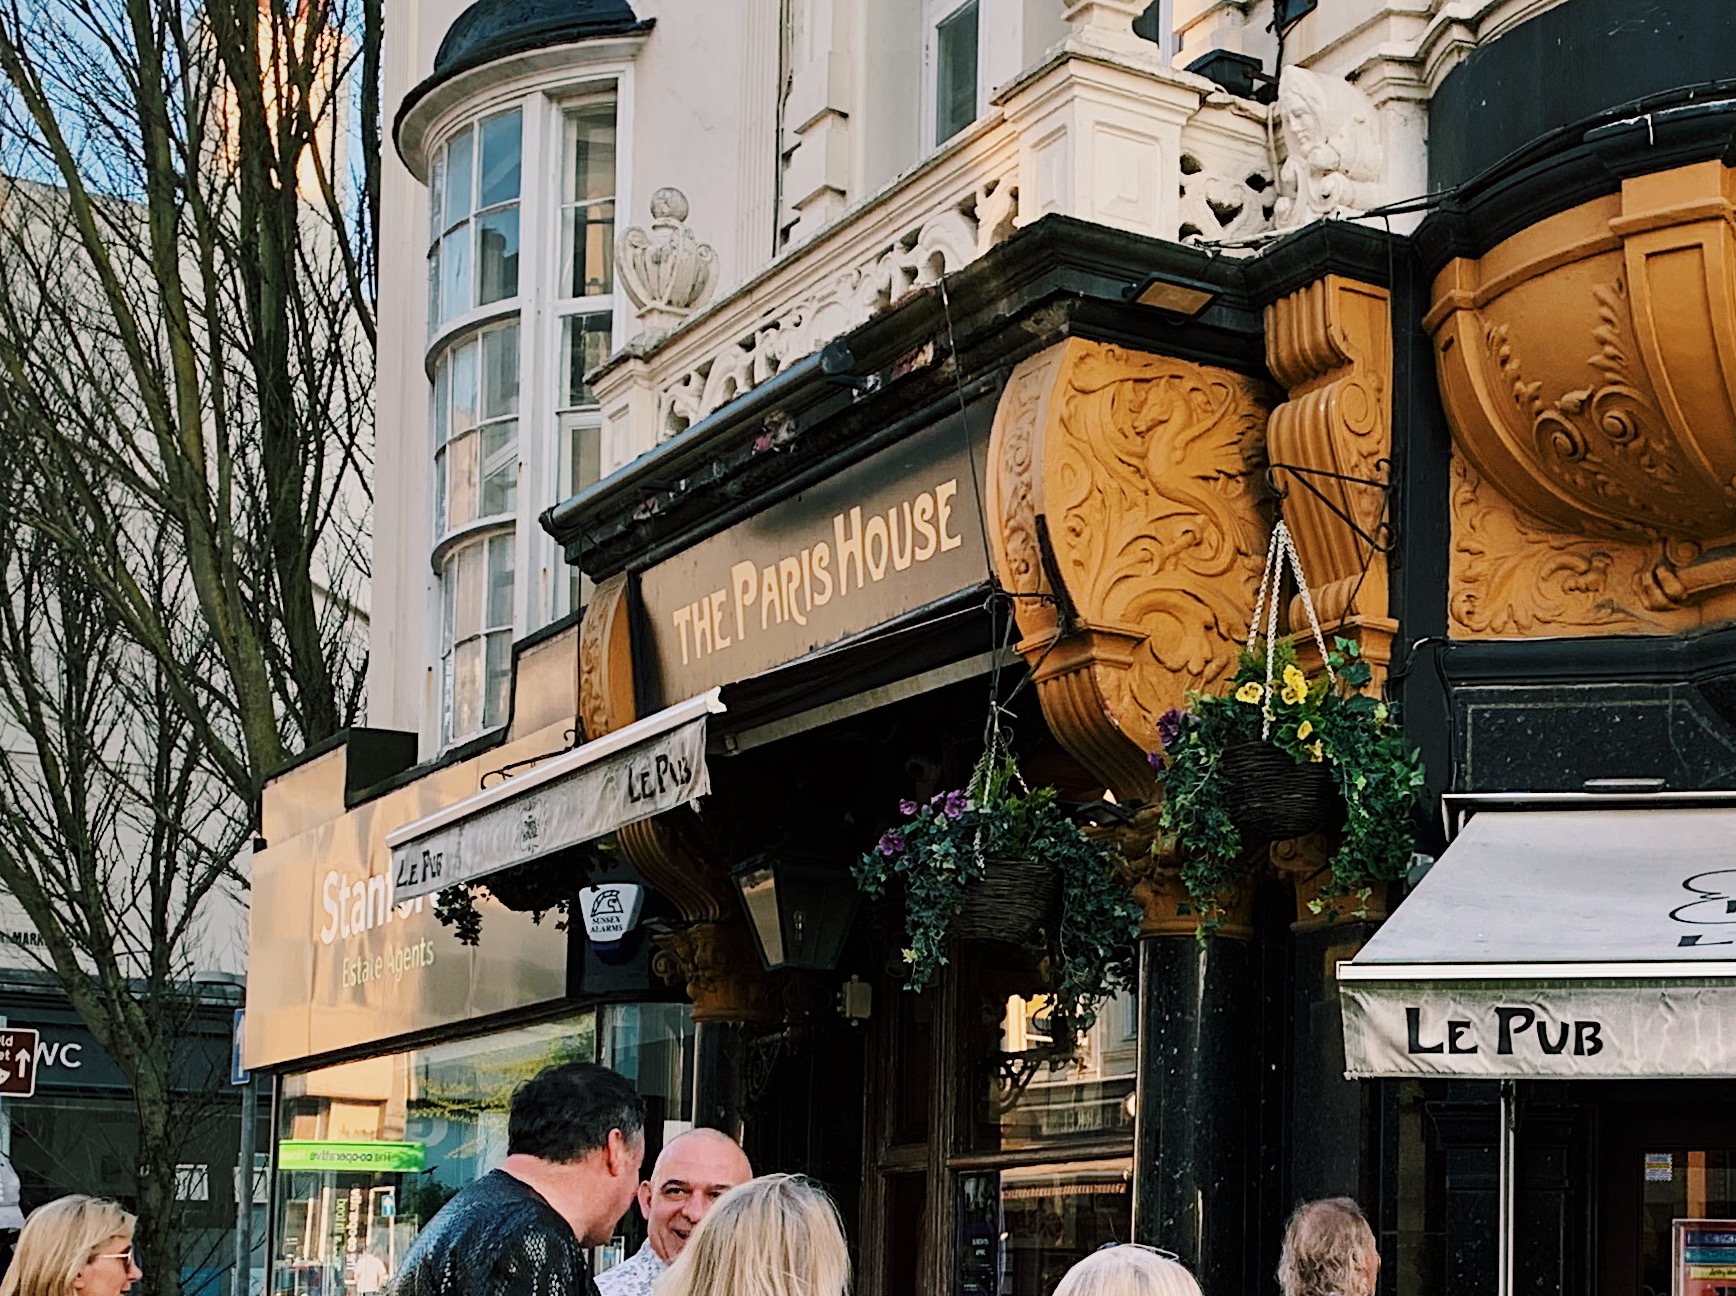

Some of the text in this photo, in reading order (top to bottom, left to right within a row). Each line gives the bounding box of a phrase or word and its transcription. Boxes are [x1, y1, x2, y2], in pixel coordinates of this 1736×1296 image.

[672, 478, 962, 665] THE PARIS HOUSE
[590, 924, 623, 932] ALARMS
[592, 915, 621, 924] SUSSEX
[342, 936, 435, 988] Estate Agents
[37, 1041, 82, 1069] WC
